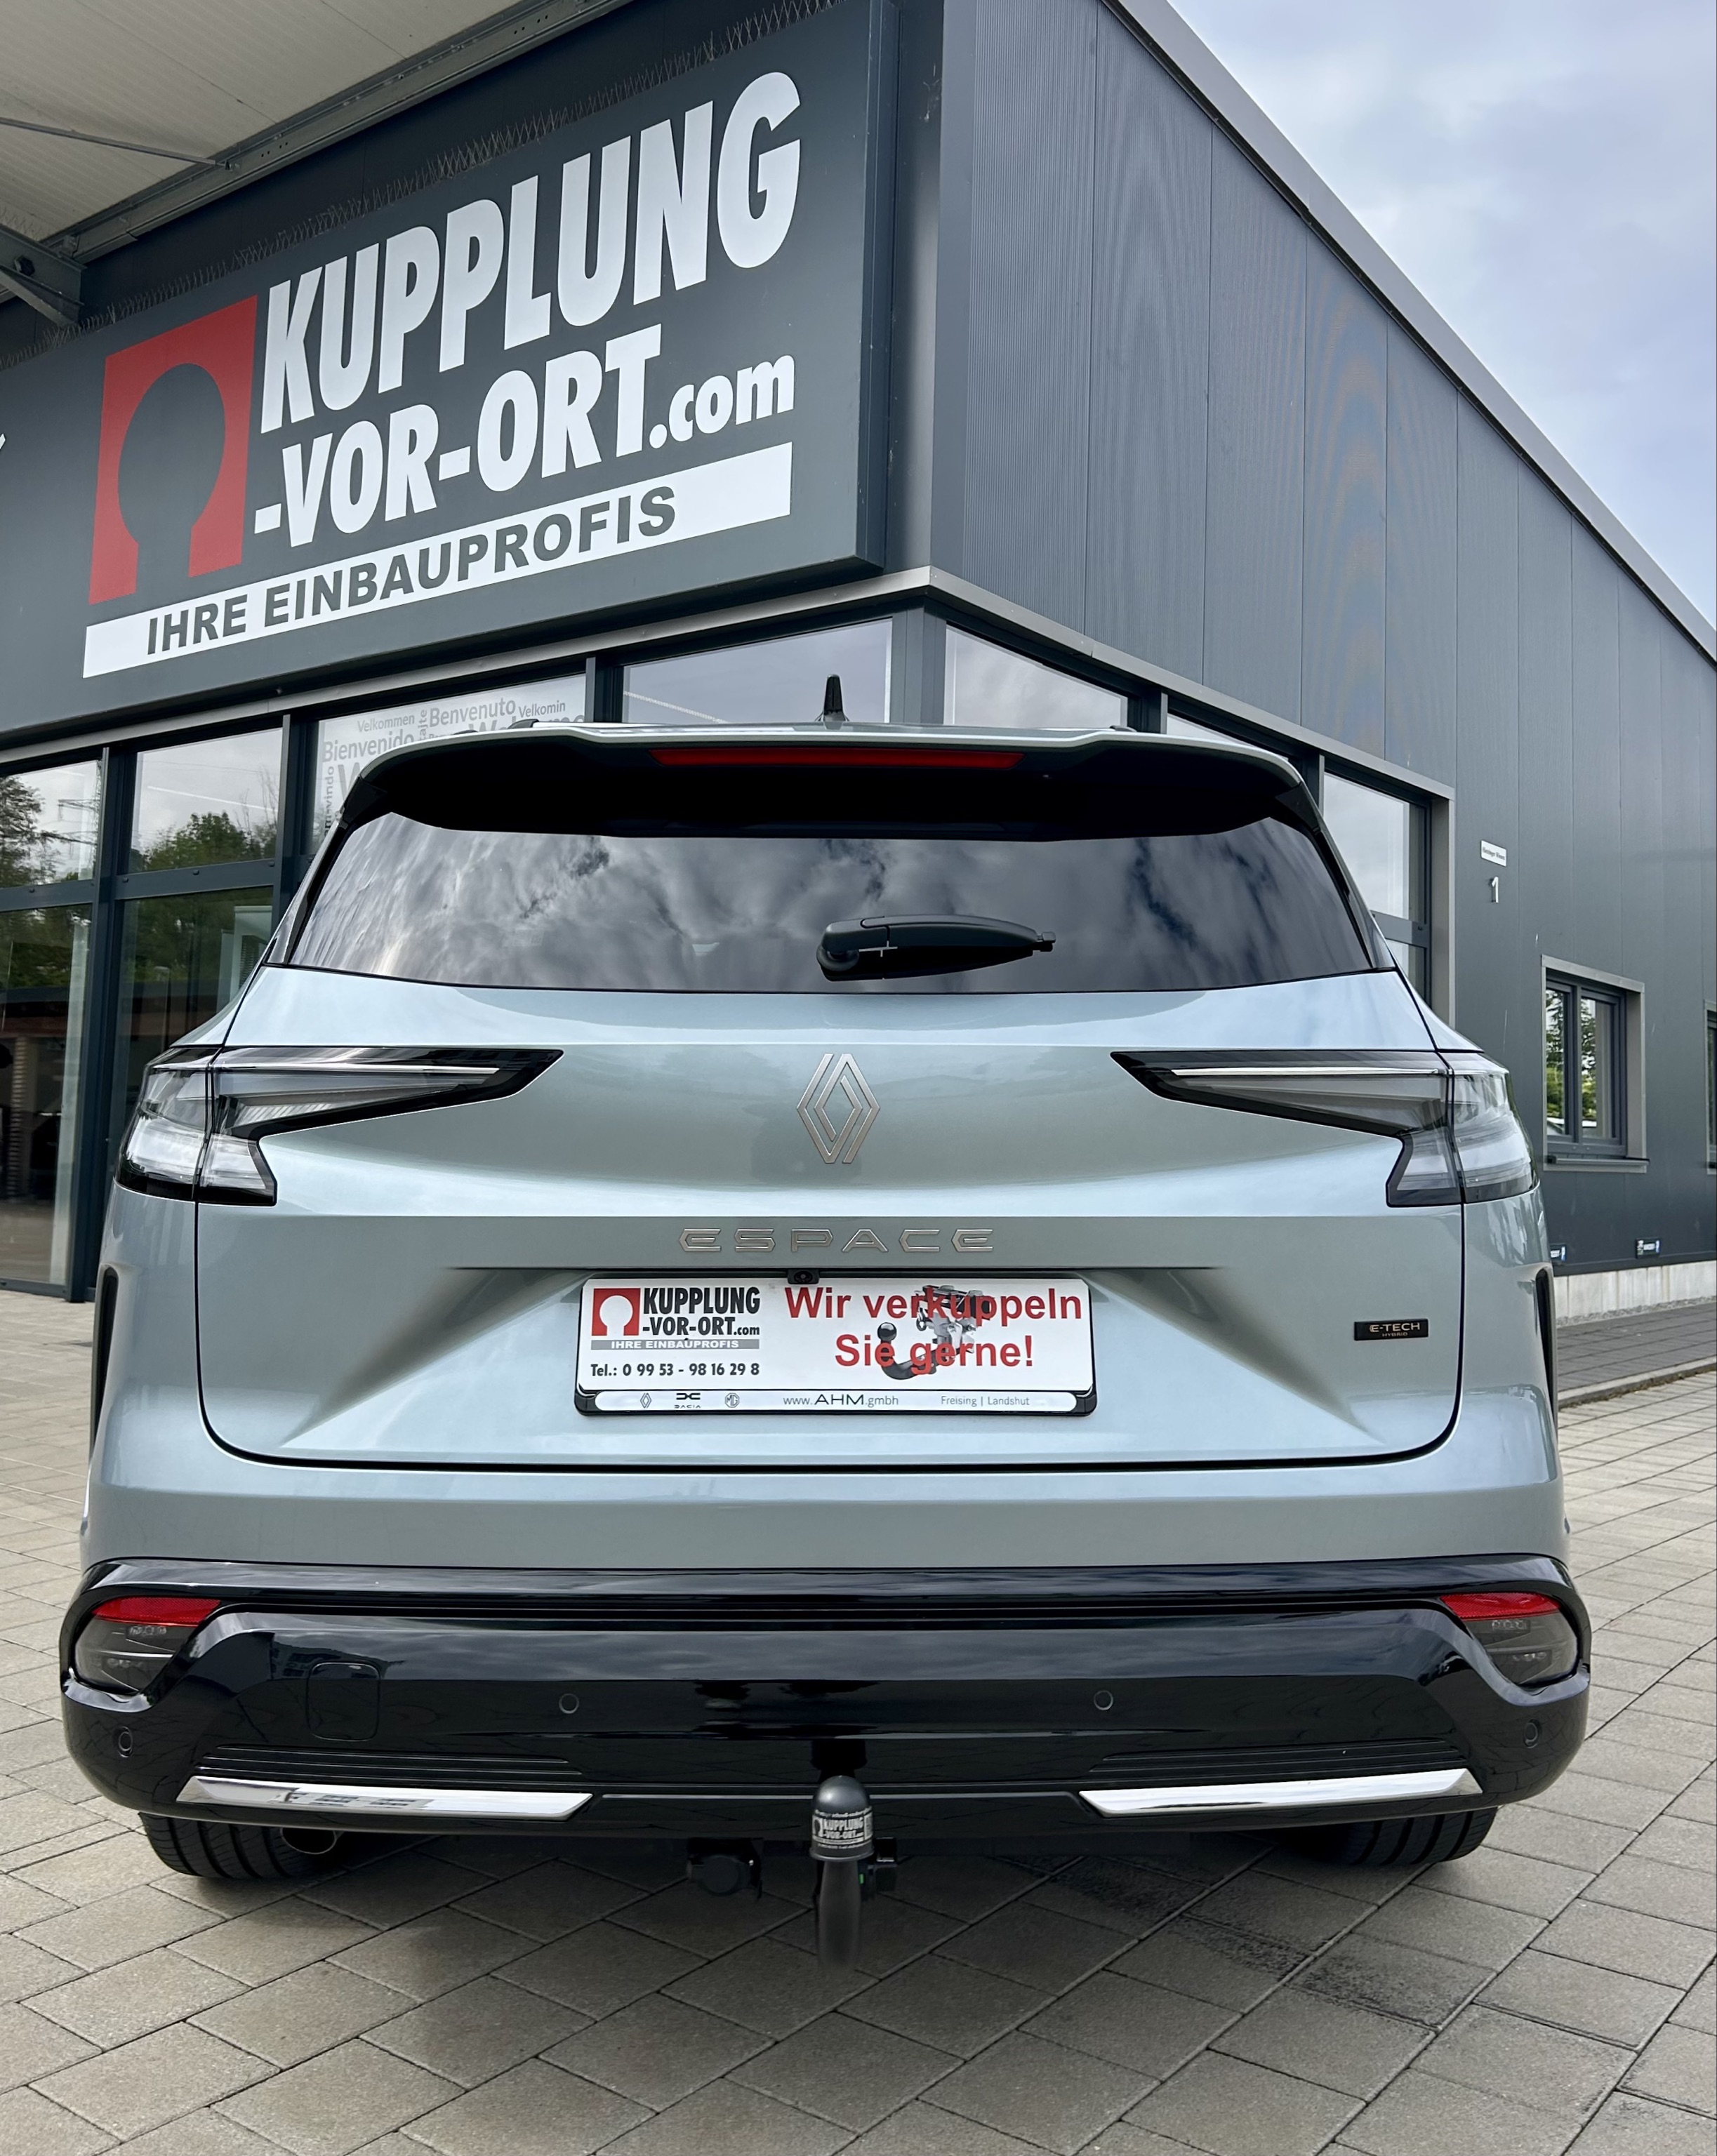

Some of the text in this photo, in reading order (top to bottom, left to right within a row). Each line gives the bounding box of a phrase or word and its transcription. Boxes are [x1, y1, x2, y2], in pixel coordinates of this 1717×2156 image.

[261, 72, 802, 434] KUPPLUNG
[254, 325, 794, 547] -VOR-ORT.com
[147, 487, 675, 654] IHRE EINBAUPROFIS
[429, 698, 516, 728] Benvenuto
[519, 700, 566, 718] Velkomin
[357, 714, 416, 733] Velkommen
[322, 727, 414, 762] Bienvenido
[1491, 876, 1499, 903] 1
[679, 1228, 994, 1253] ESPACE
[643, 1286, 760, 1315] KUPPLUNG
[785, 1286, 1082, 1326] Wir verkuppeln
[642, 1316, 760, 1336] -VOR-ORT.com
[1370, 1322, 1419, 1332] E-TECH
[611, 1340, 739, 1349] IHRE EINBAUPROFIS
[835, 1333, 1033, 1376] Sie gerne!
[590, 1364, 618, 1376] Tel.:
[623, 1364, 632, 1376] 0
[637, 1364, 654, 1376] 99
[659, 1364, 674, 1376] 53
[689, 1363, 707, 1376] 98
[711, 1363, 724, 1376] 16
[730, 1363, 746, 1376] 29
[750, 1363, 760, 1376] 8
[783, 1393, 899, 1409] www.AHM.gmbh
[941, 1395, 977, 1407] Freising
[987, 1395, 1030, 1406] Landshut
